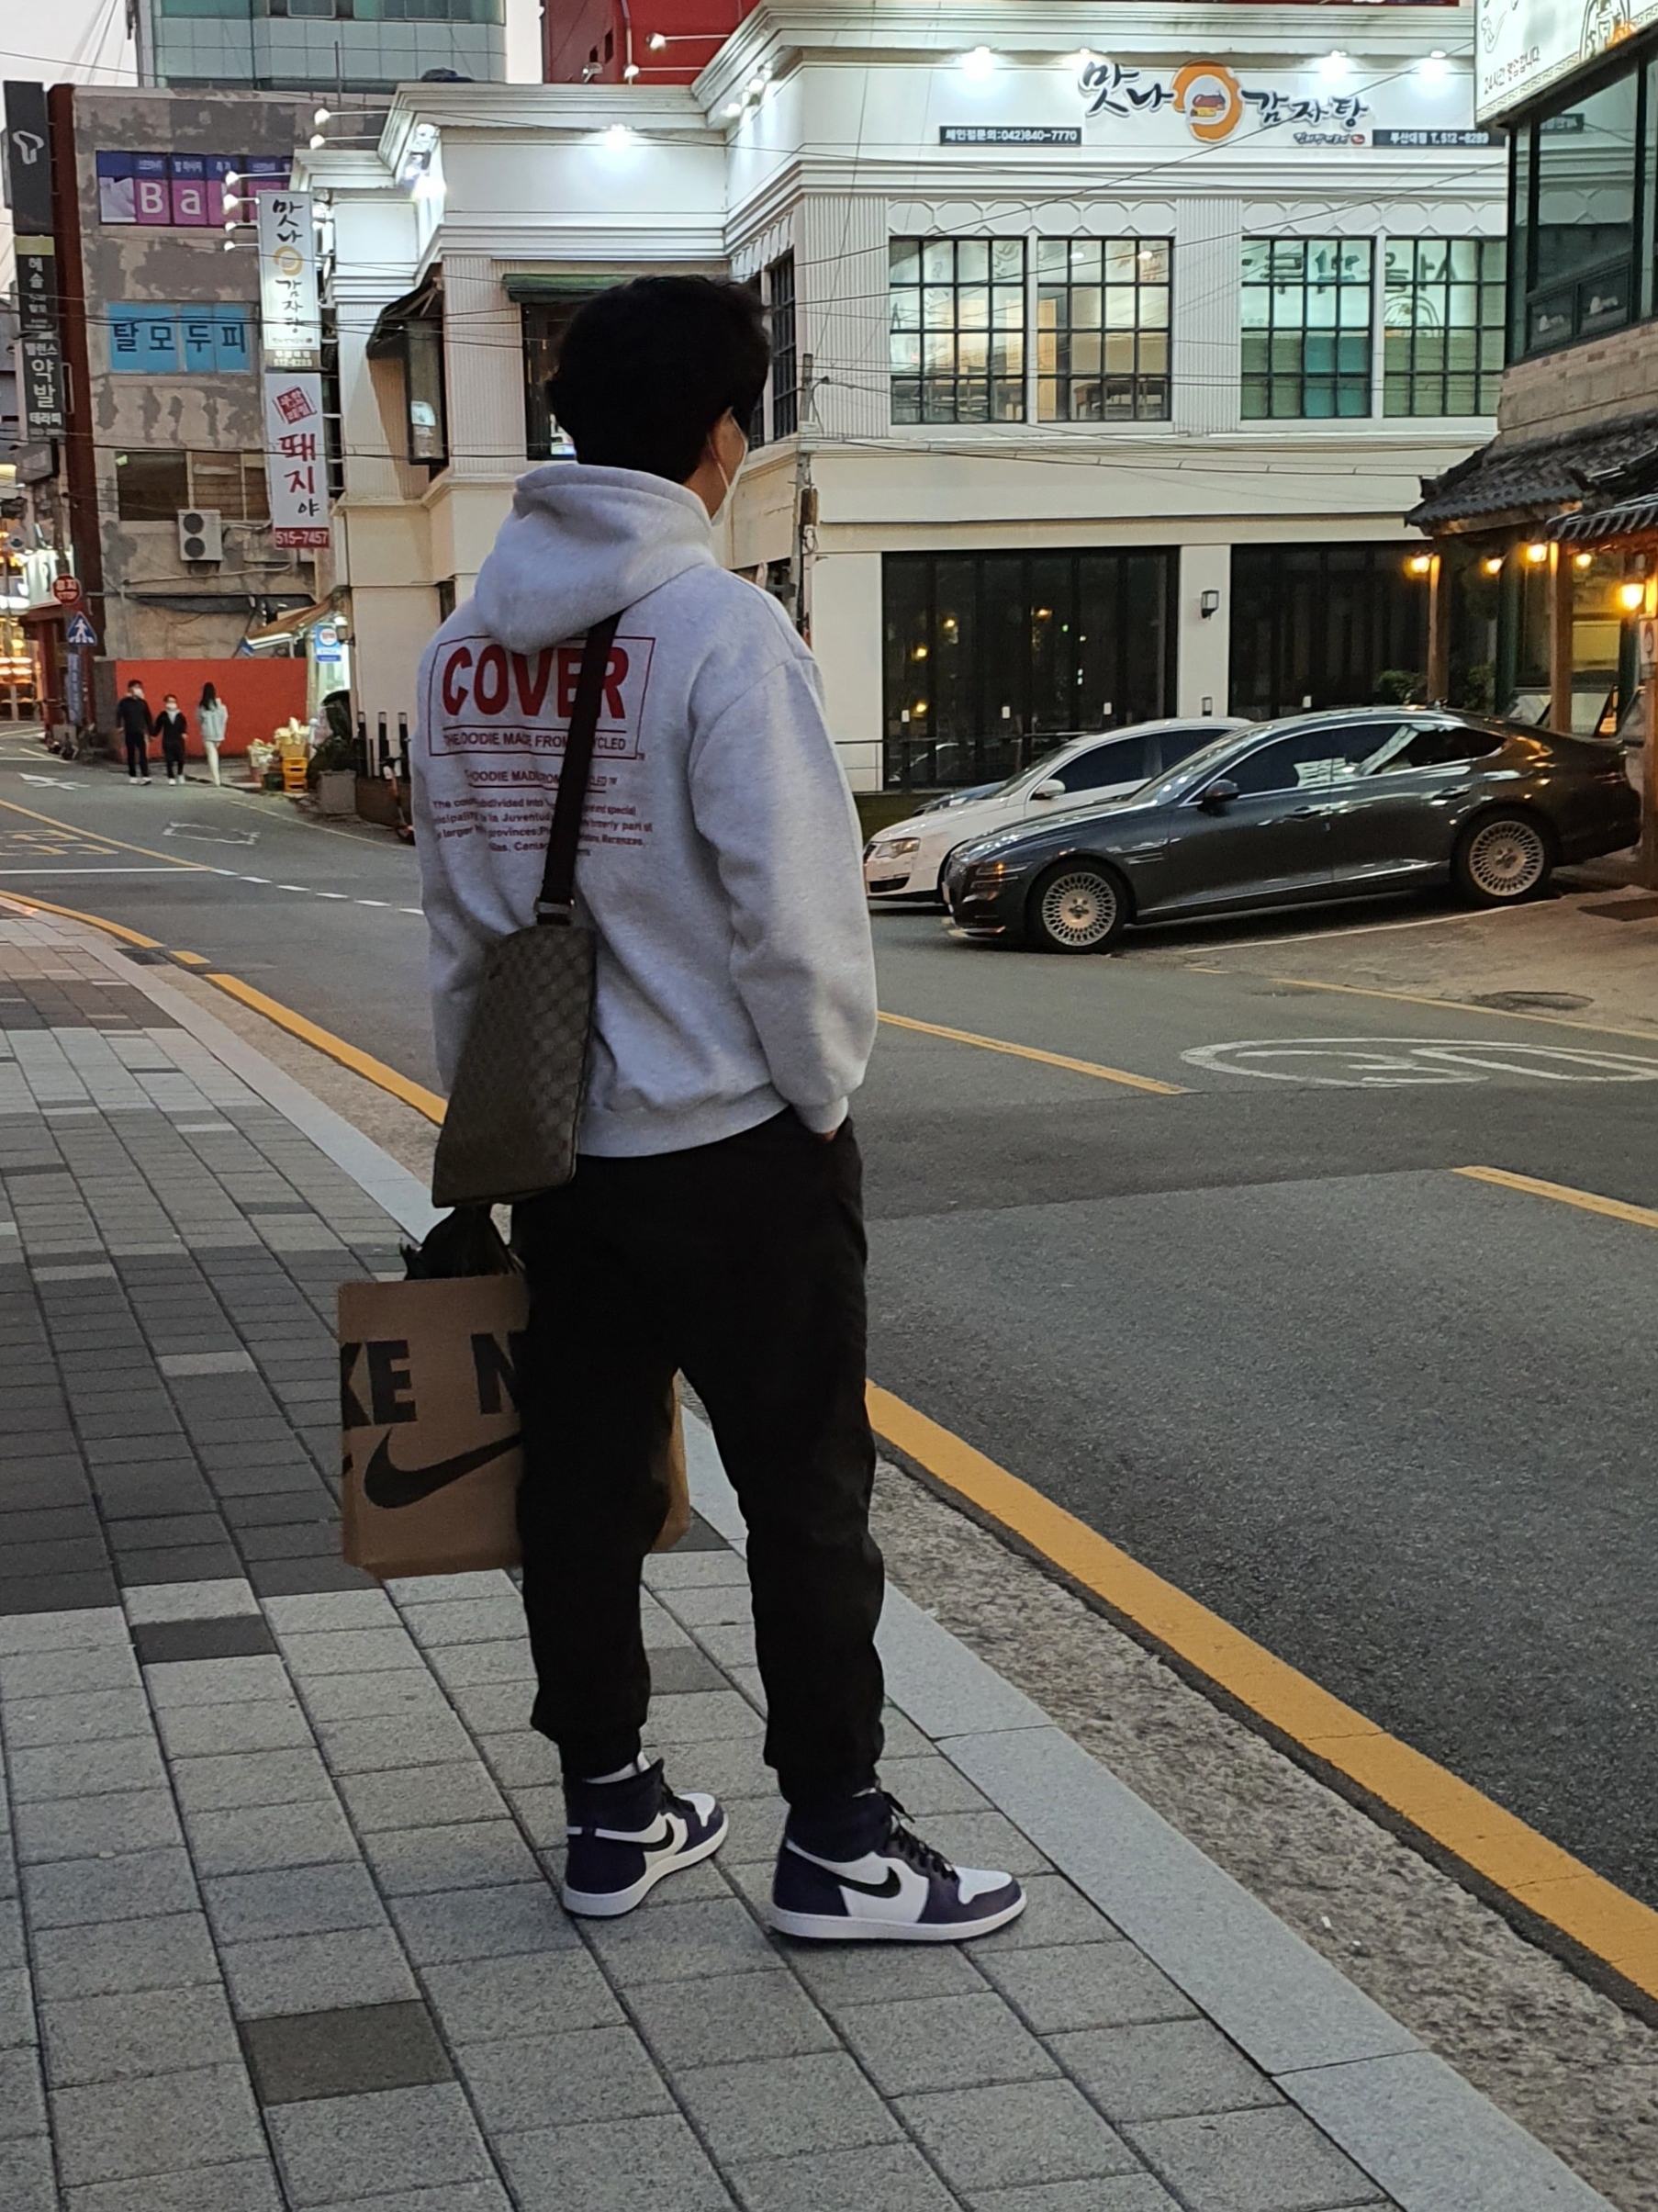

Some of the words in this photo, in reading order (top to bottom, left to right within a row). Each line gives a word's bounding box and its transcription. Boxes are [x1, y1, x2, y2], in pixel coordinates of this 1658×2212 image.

[1081, 62, 1174, 114] 맛나
[1241, 89, 1368, 128] 감자탕
[273, 198, 304, 242] 맛나
[113, 322, 246, 354] 탈모두피
[31, 359, 56, 409] 약발
[275, 531, 328, 545] 515-7457
[443, 644, 629, 719] COVER
